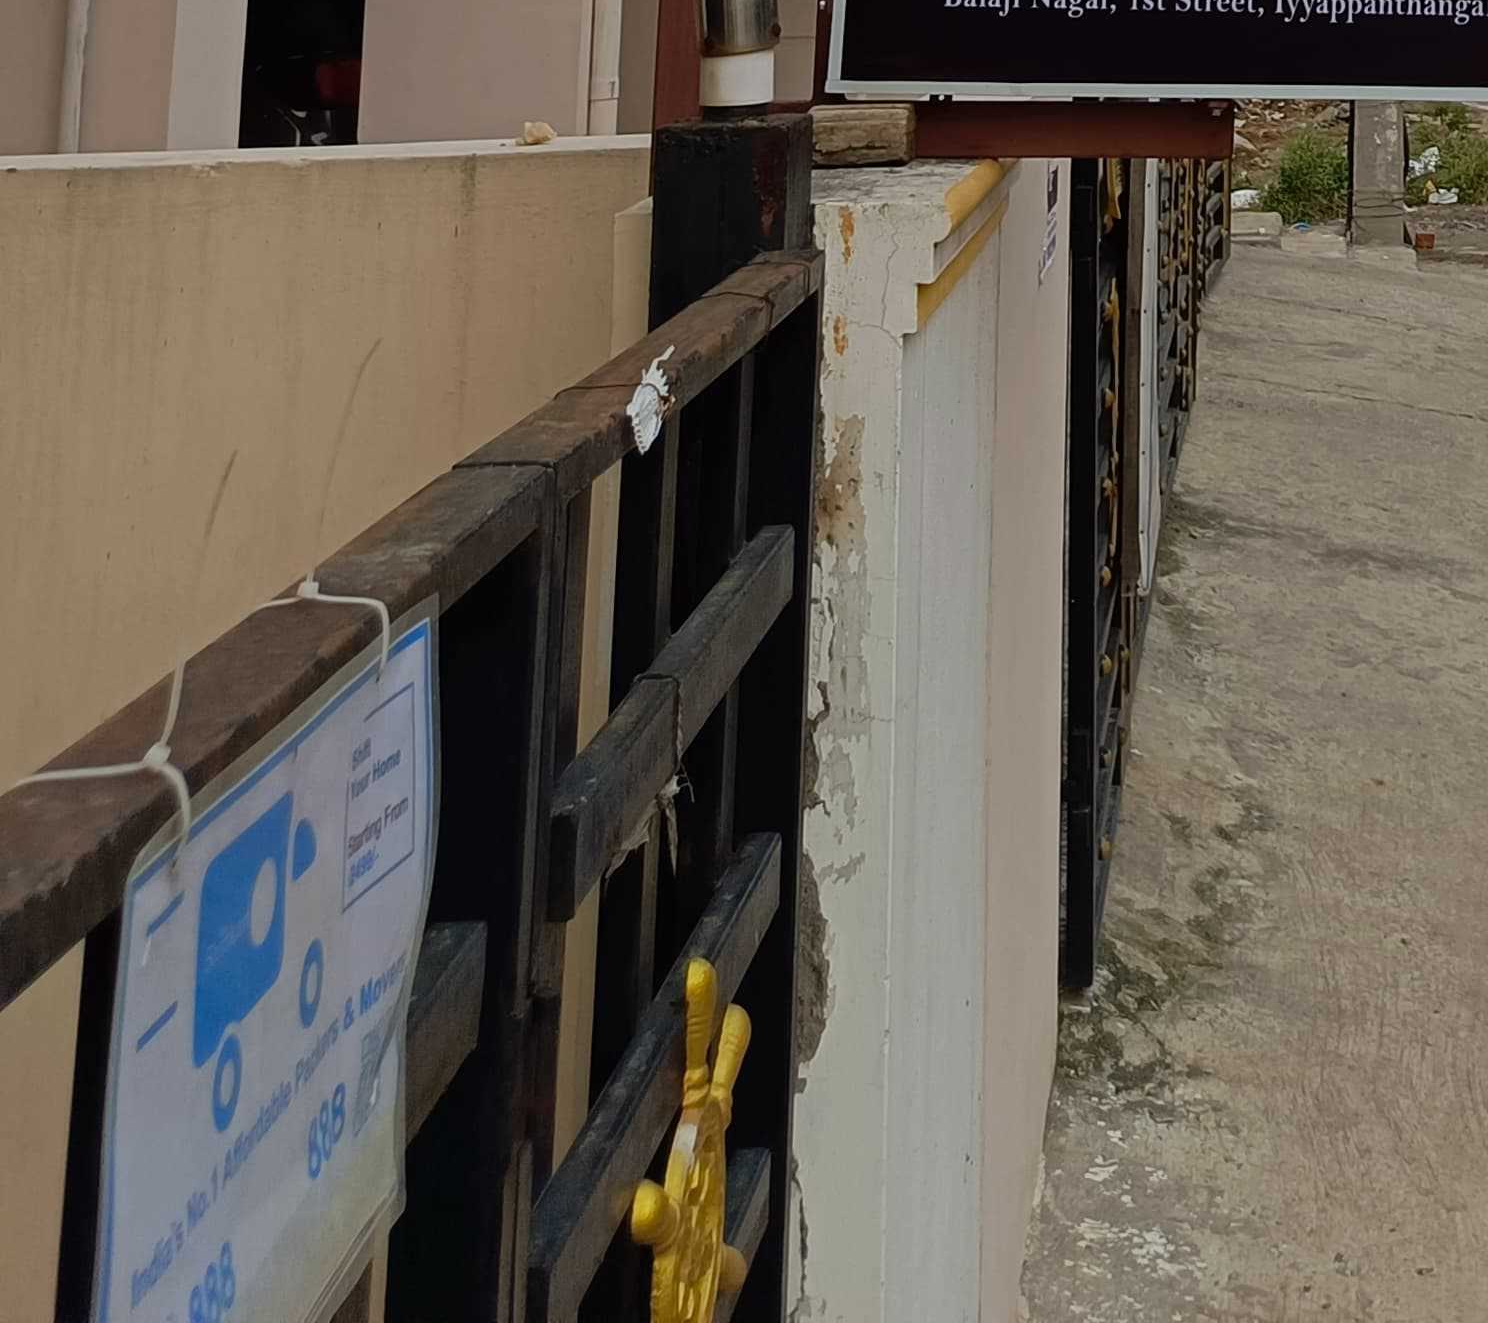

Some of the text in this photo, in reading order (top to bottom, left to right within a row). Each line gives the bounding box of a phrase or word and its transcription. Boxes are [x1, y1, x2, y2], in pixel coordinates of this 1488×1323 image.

[372, 749, 401, 783] Home
[348, 796, 409, 858] Starting From
[131, 1221, 184, 1311] India's
[223, 1081, 293, 1189] Affordable
[294, 1019, 340, 1093] Packers
[344, 996, 353, 1031] &
[308, 1081, 346, 1180] 888
